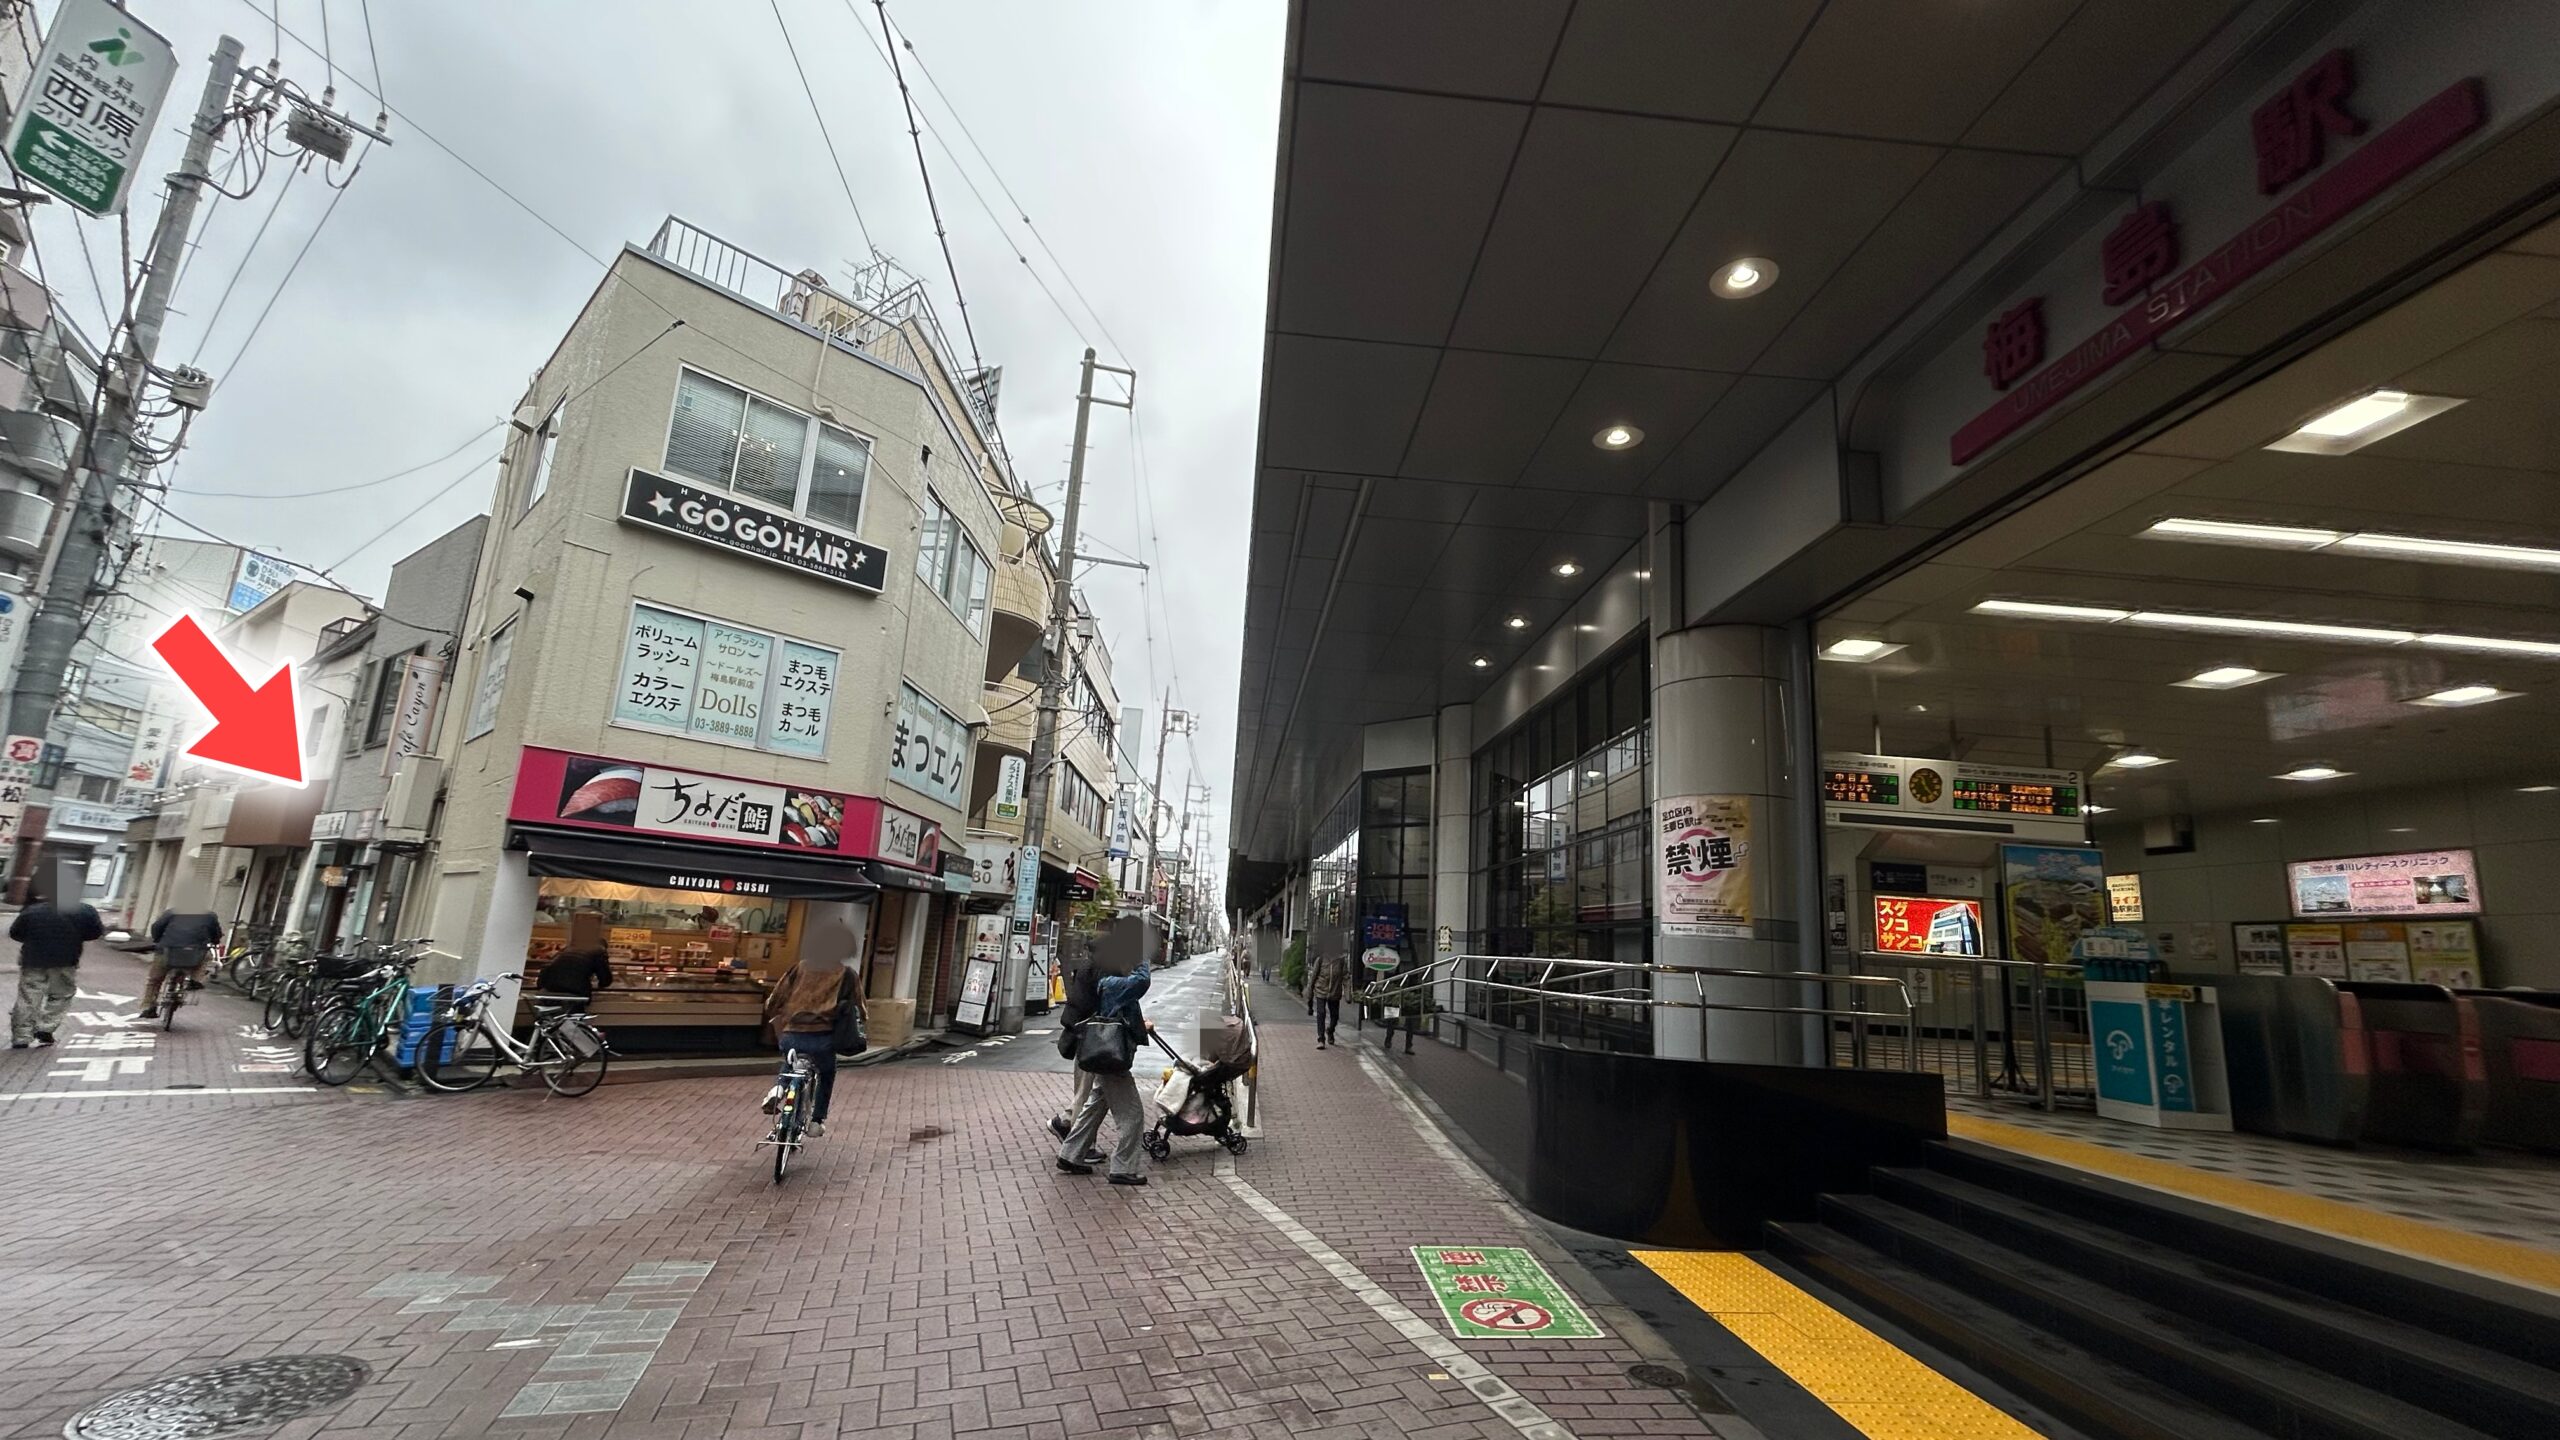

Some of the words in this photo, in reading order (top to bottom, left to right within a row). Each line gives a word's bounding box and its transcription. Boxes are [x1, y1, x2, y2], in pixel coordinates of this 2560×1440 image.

[43, 68, 140, 149] 西原
[36, 101, 127, 160] クリニック
[1983, 47, 2369, 392] 梅島駅
[2010, 322, 2131, 415] UMEJIMA
[2146, 200, 2312, 325] STATION
[681, 487, 741, 513] HAIR
[766, 515, 851, 548] STUDIO
[680, 500, 730, 532] GO
[734, 517, 781, 549] GO
[783, 531, 848, 570] HAIR
[635, 624, 698, 650] ボリューム
[714, 628, 765, 650] アイラッシュ
[637, 643, 691, 667] ラッシュ
[710, 672, 755, 689] 梅島駅前店
[788, 659, 828, 681] まつ毛
[632, 672, 685, 692] カラー
[780, 675, 831, 697] エクステ
[628, 691, 682, 712] エクステ
[700, 688, 758, 719] Dolls
[781, 702, 821, 722] まつ毛
[694, 717, 754, 738] 03-3889-8888
[892, 719, 963, 794] まつエク
[2069, 772, 2077, 785] 2
[650, 777, 770, 832] ちよだ鮨
[1662, 805, 1693, 821] 足立区内
[1662, 817, 1702, 833] 主要6駅は
[1665, 836, 1736, 876] 禁煙
[669, 875, 720, 889] CHIYODA
[736, 881, 770, 893] SUSHI
[1880, 900, 1908, 917] スグ
[1880, 917, 1909, 932] ソコ
